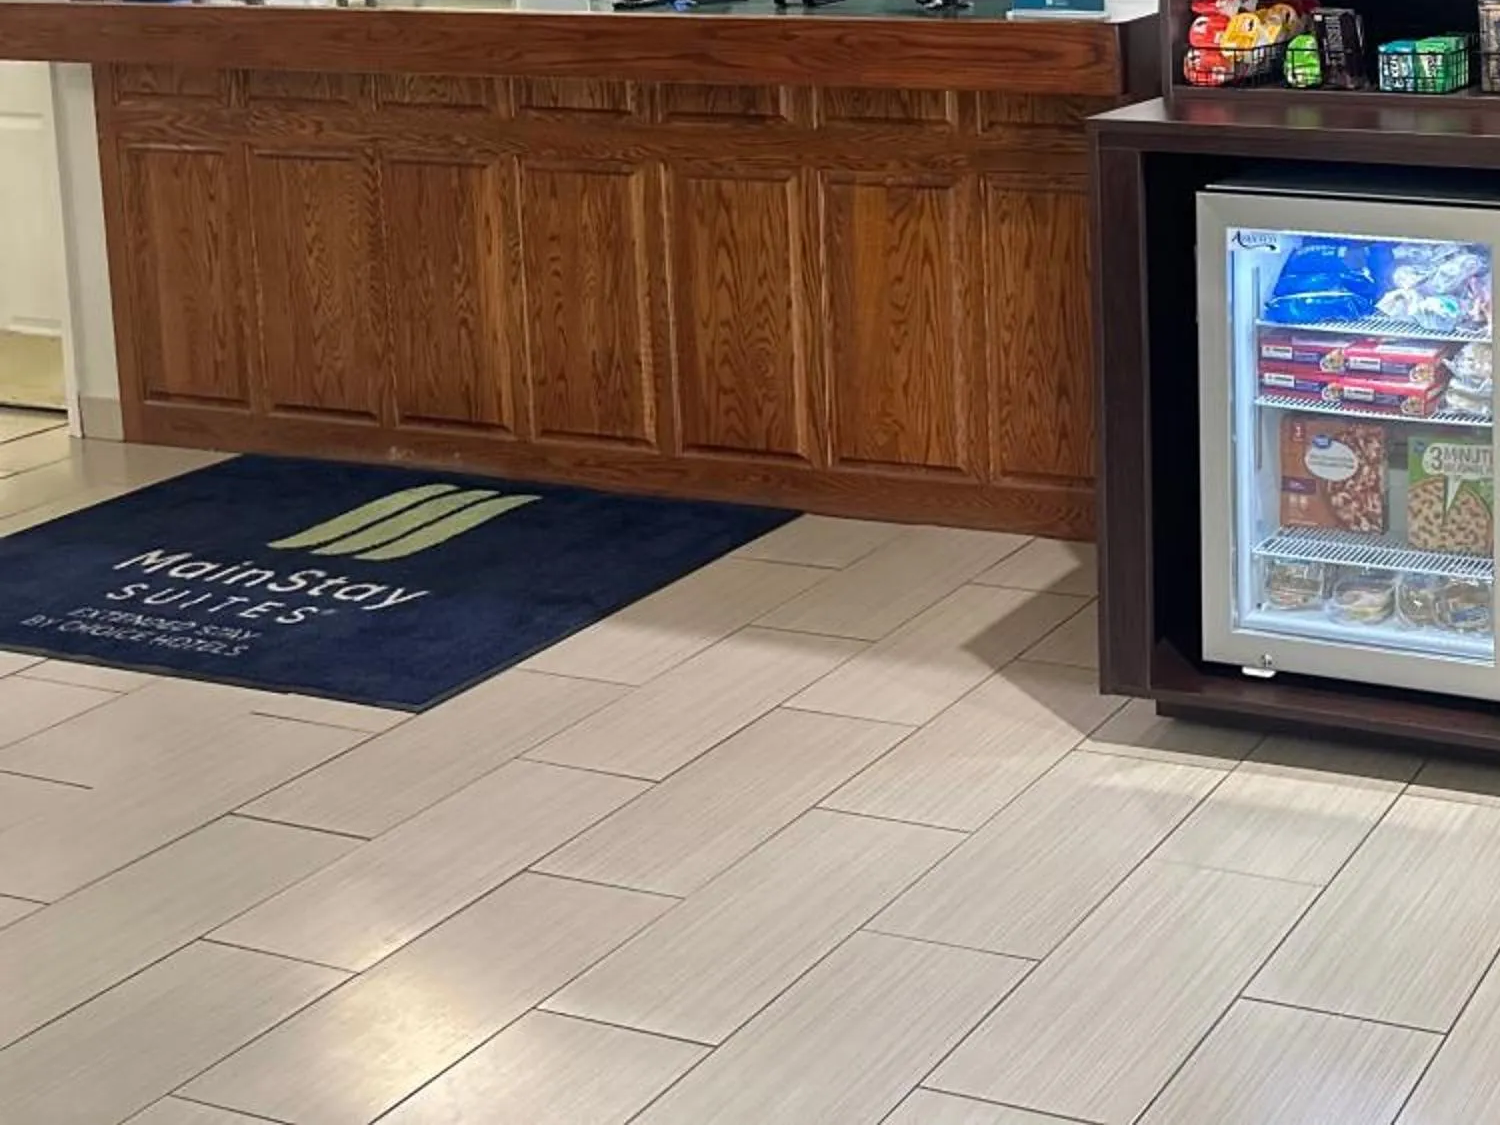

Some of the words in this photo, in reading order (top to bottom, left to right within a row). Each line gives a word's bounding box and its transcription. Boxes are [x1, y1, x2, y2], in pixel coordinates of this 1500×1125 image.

[1430, 446, 1443, 471] 3
[112, 548, 431, 611] MainStay
[68, 607, 197, 632] EXTENDED
[106, 582, 320, 625] SUITES
[20, 614, 61, 627] BY
[58, 620, 153, 641] CHOICE
[150, 634, 250, 657] HOTELS
